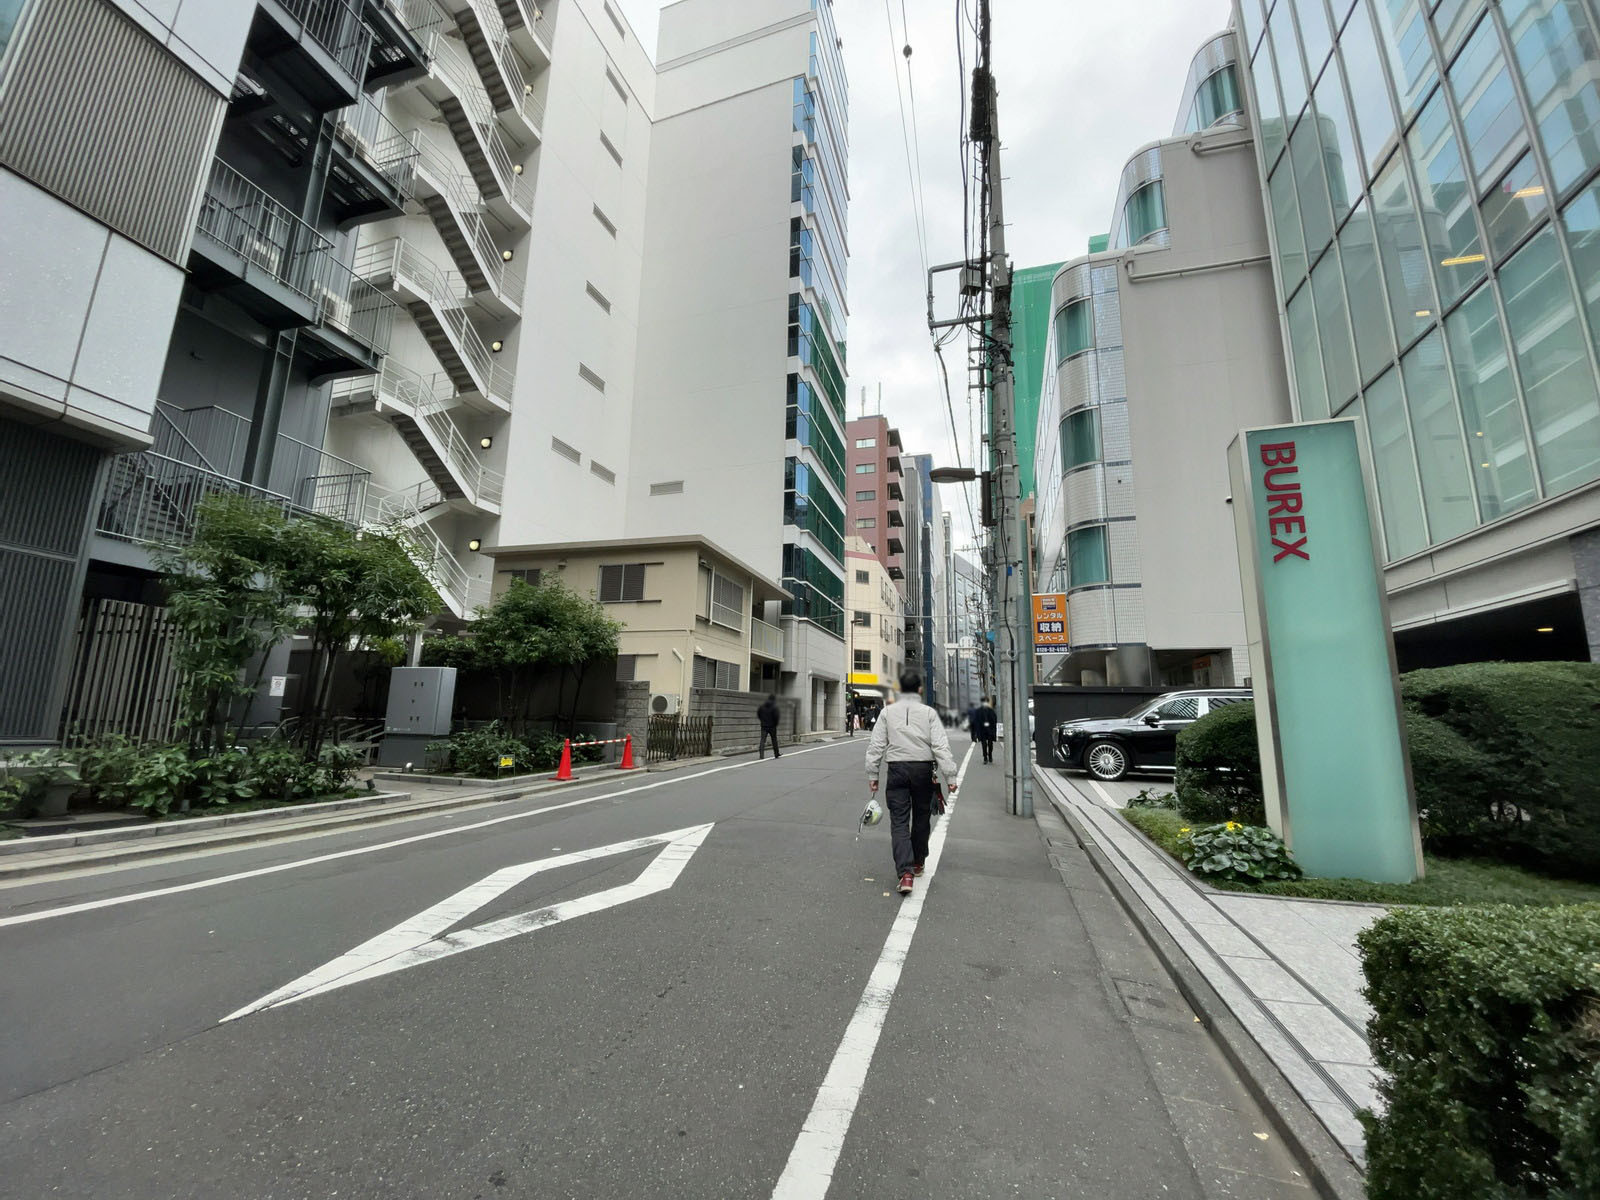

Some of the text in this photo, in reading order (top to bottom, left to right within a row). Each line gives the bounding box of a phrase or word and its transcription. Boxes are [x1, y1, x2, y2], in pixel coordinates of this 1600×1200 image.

[1260, 441, 1310, 564] BUREX
[1037, 612, 1063, 620] レンタル
[1039, 622, 1062, 633] 収納
